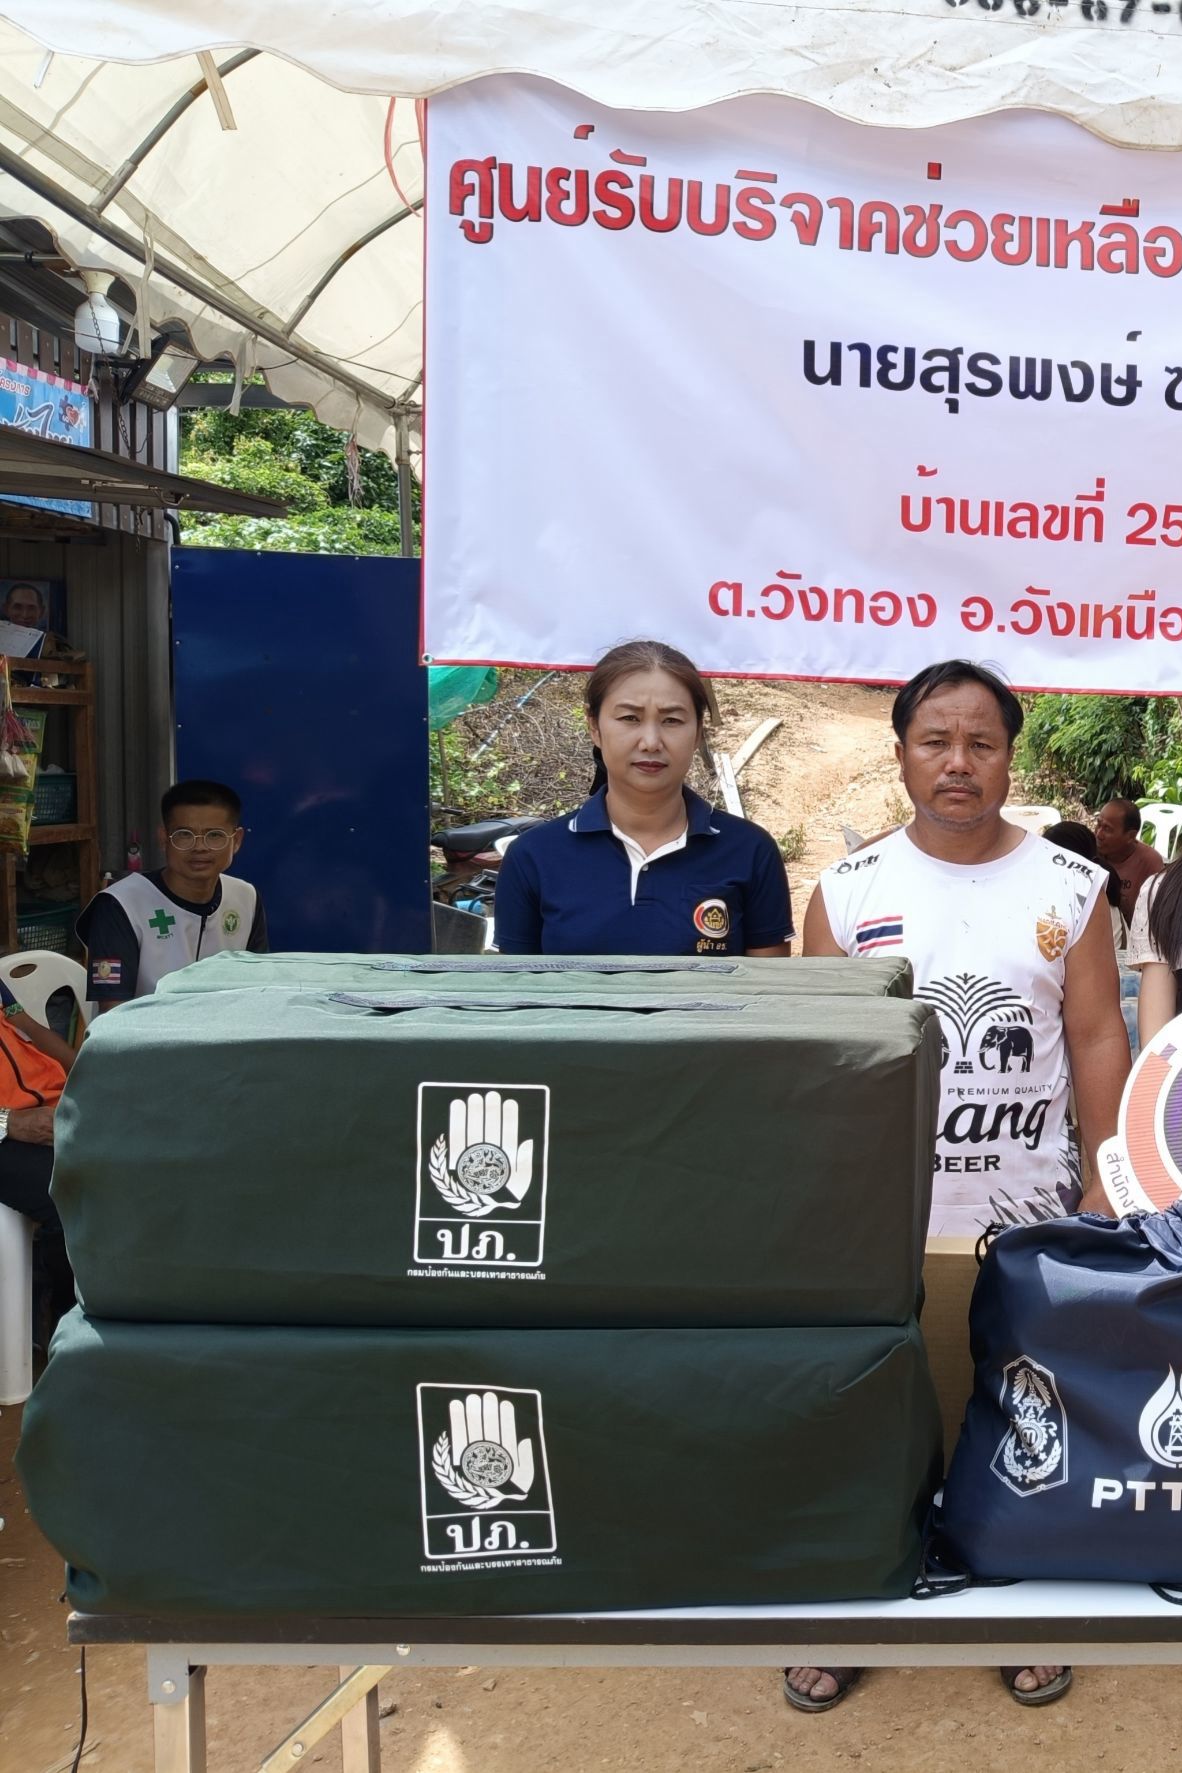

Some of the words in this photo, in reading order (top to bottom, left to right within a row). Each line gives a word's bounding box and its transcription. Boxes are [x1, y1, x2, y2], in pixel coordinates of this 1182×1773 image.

[803, 330, 1142, 414] นายสุรพงษ์
[900, 464, 1105, 543] บ้านเลขที่
[708, 569, 937, 628] ต.วังทอง
[947, 1087, 1009, 1096] PREMIUM
[1014, 1083, 1053, 1095] QUALITY
[936, 1099, 1052, 1150] ang
[436, 1223, 516, 1260] ปภ.
[446, 1516, 530, 1552] ปภ.
